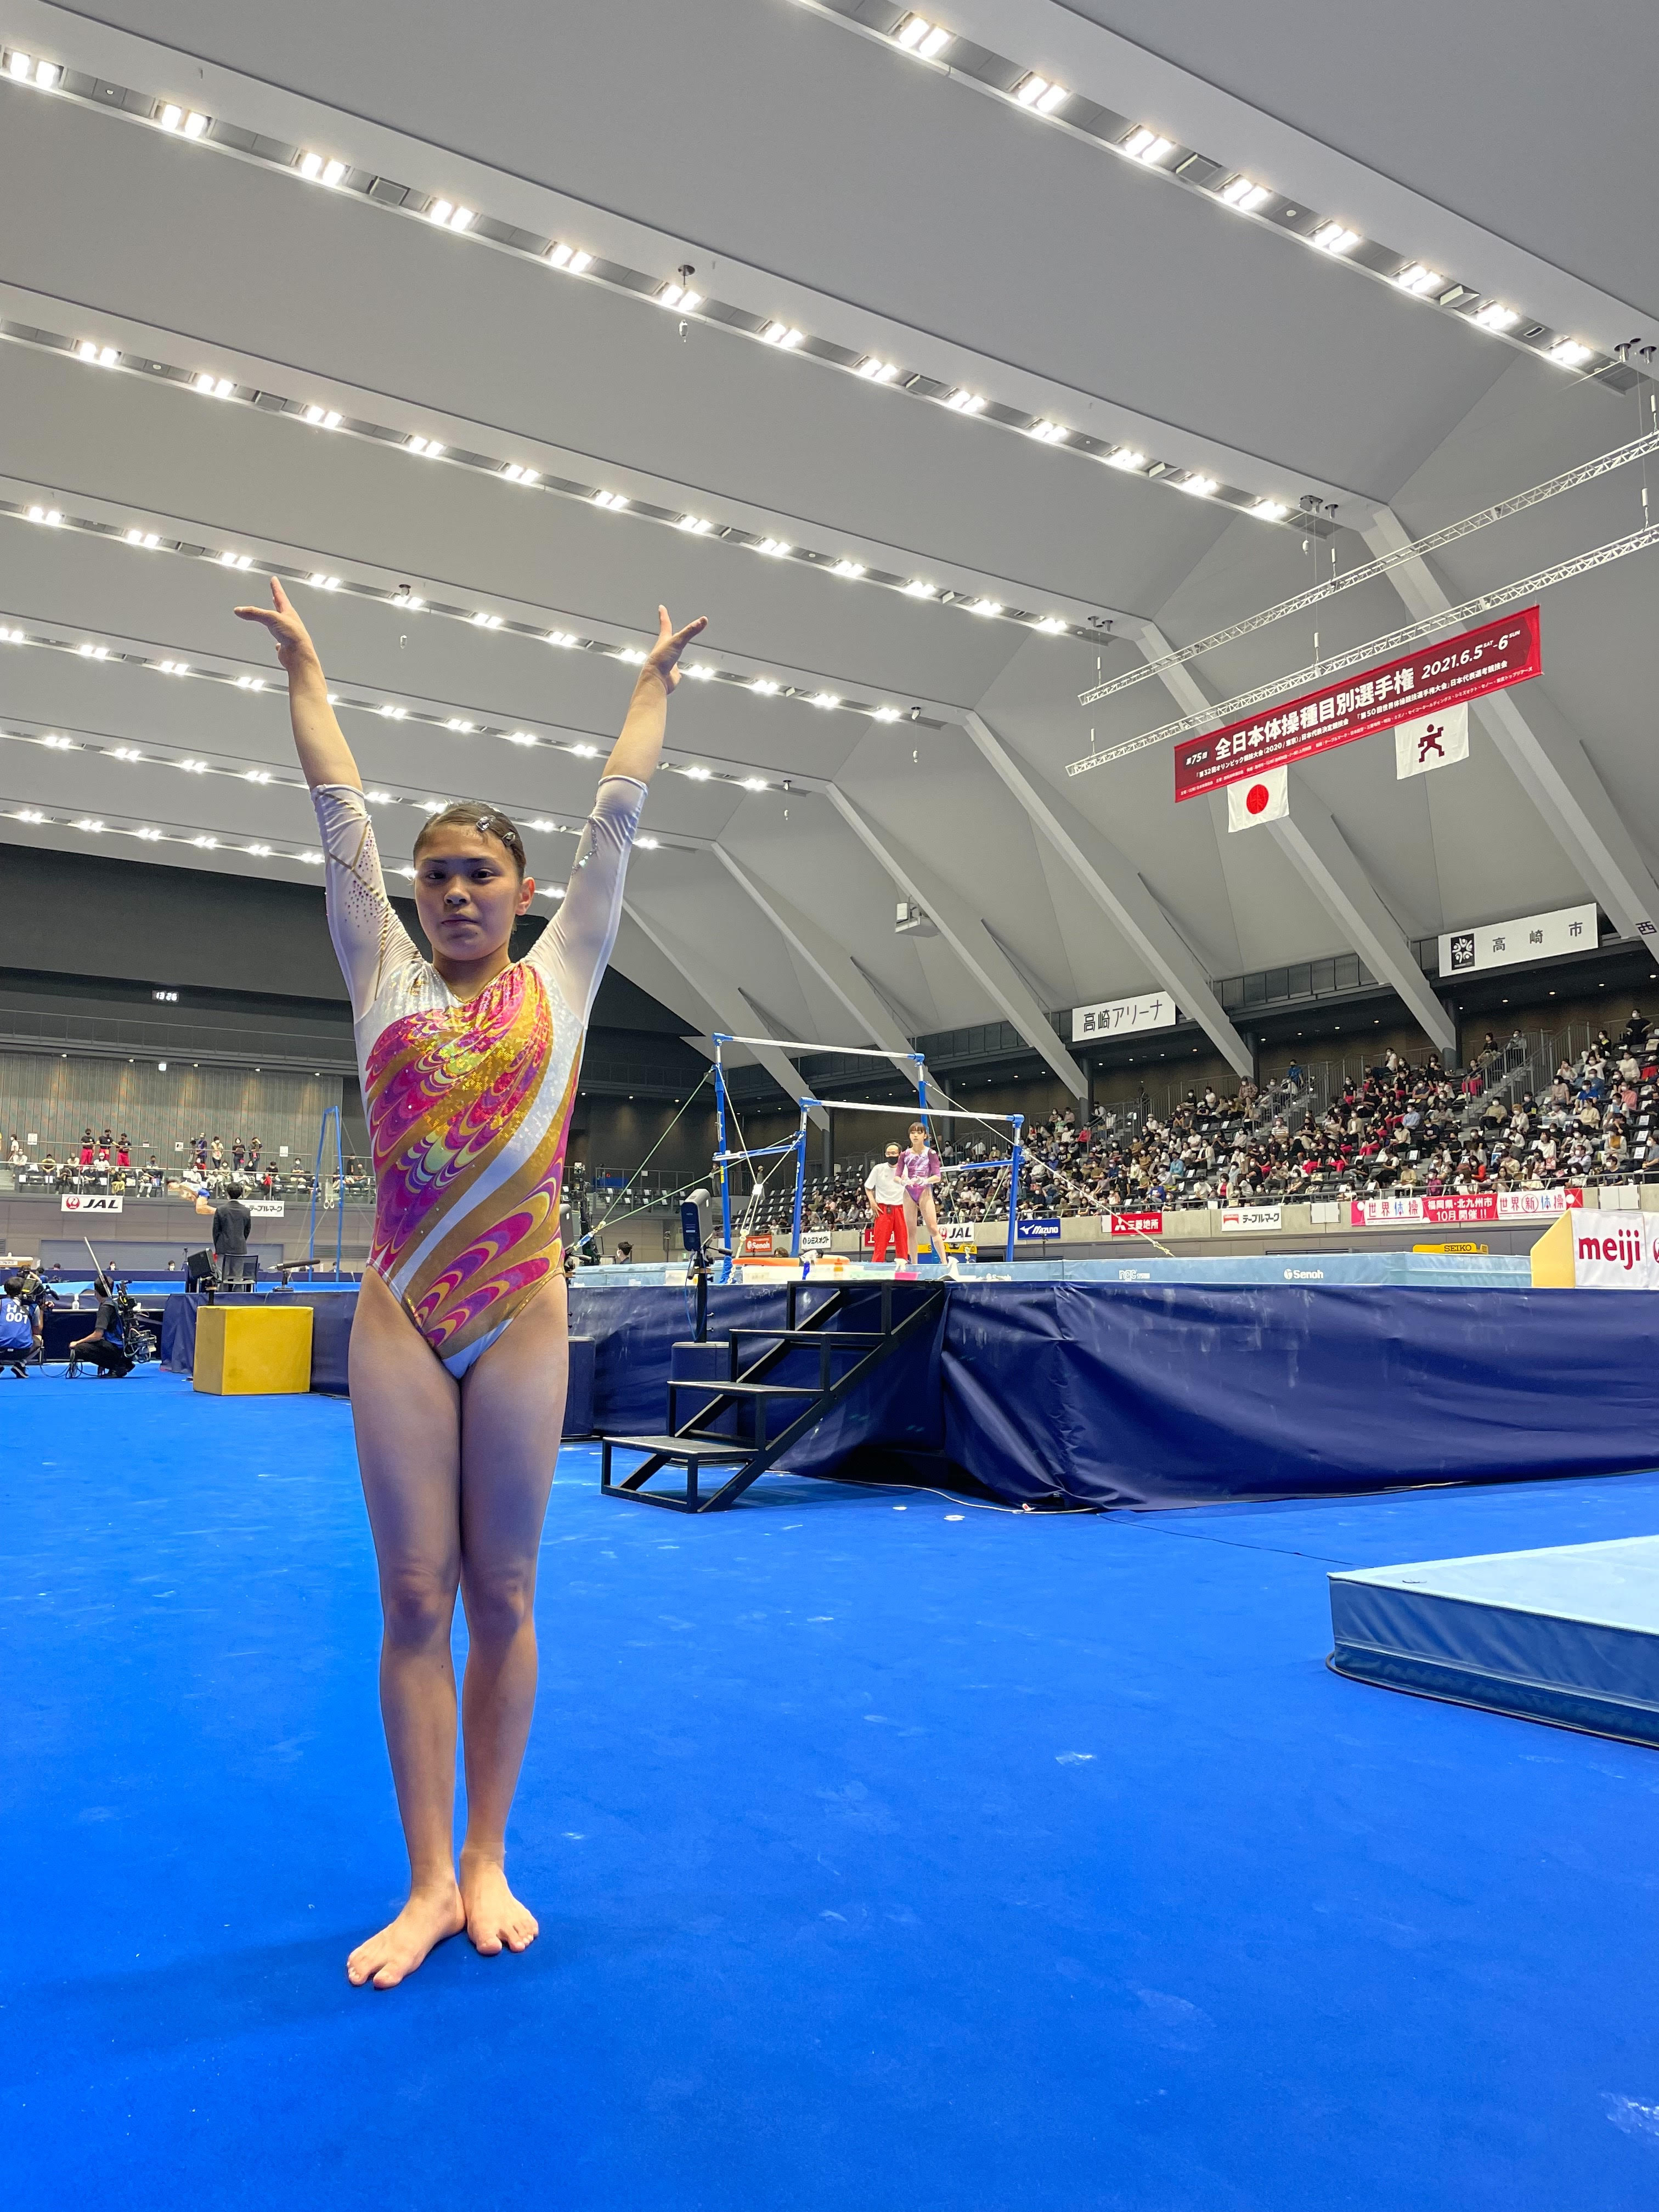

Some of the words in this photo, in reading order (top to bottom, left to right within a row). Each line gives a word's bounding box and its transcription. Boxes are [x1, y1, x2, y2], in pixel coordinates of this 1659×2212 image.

[1186, 750, 1208, 766] 第75回
[1215, 667, 1414, 761] 全日本体操種目別選手権
[1635, 921, 1657, 935] 西
[1492, 922, 1583, 952] 高崎市
[1084, 1000, 1163, 1032] 高崎アリーナ
[83, 1199, 118, 1209] JAL
[1369, 1200, 1418, 1217] 世界体操
[1428, 1197, 1492, 1210] 福岡県・北九州市
[1500, 1195, 1564, 1211] 世界新体操
[1127, 1219, 1159, 1230] 三菱地所
[1243, 1213, 1279, 1223] テーブルマーク
[949, 1227, 972, 1239] JAL
[752, 1241, 770, 1249] Senoh
[1579, 1229, 1640, 1270] meiji
[1293, 1269, 1324, 1279] Senoh
[6, 1312, 28, 1324] 001
